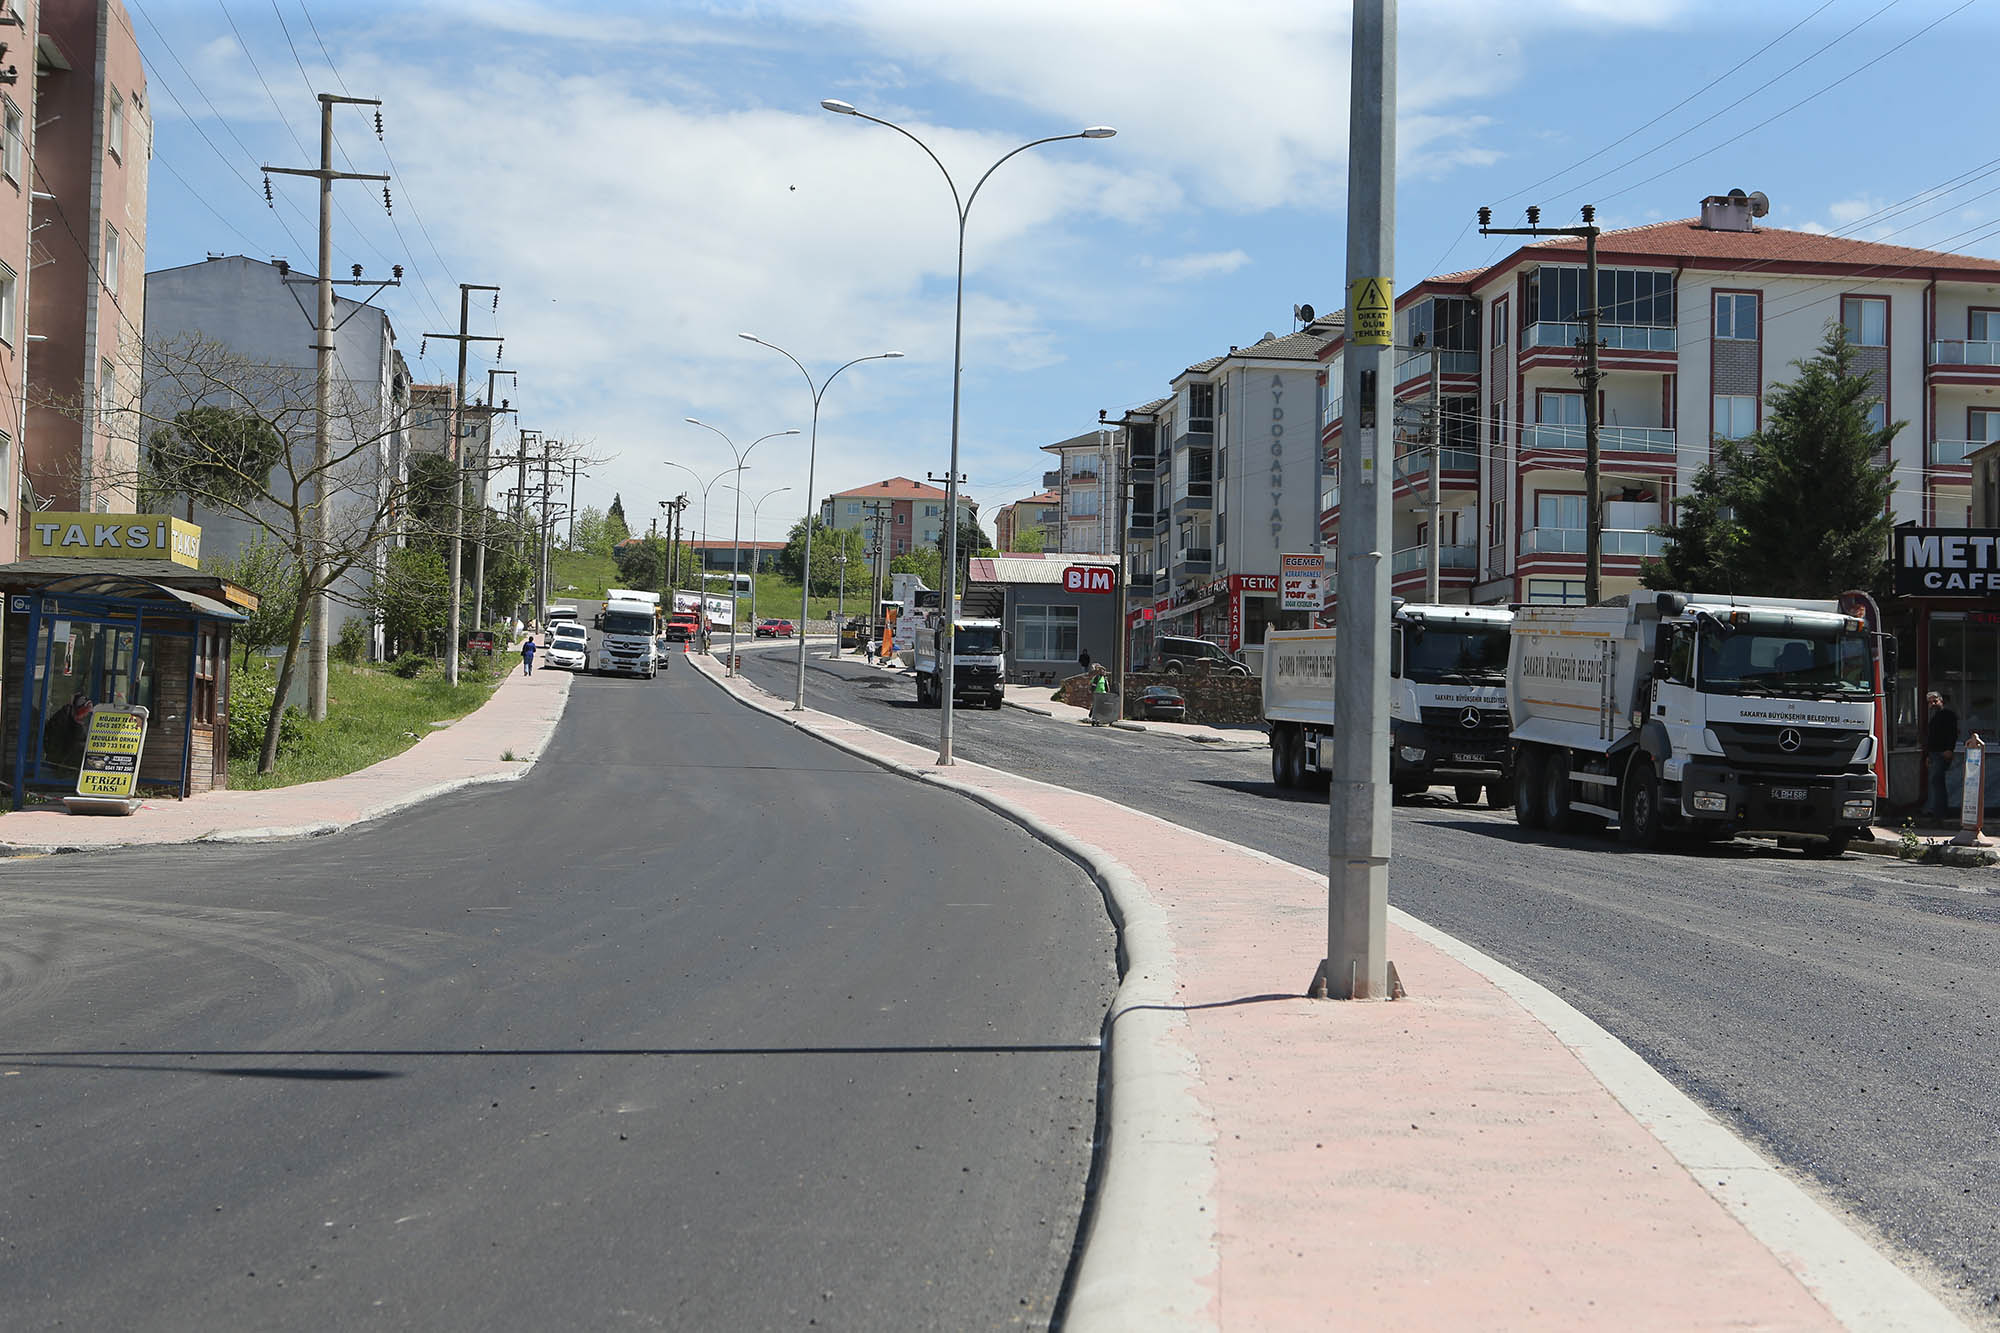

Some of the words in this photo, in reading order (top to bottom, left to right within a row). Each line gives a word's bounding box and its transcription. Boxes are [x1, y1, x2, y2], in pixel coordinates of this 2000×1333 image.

[36, 522, 166, 549] TAKSİ
[172, 529, 200, 560] TAKSİ
[1904, 536, 2000, 569] MET
[1286, 558, 1322, 566] EGEMEN
[1068, 568, 1110, 590] BİM
[1240, 576, 1276, 588] TETİK
[1285, 580, 1302, 590] ÇAY
[1924, 572, 2000, 590] CAFE
[1285, 591, 1306, 599] TOST
[1524, 656, 1544, 676] SAKARYA
[1740, 710, 1767, 719] SAKARYA
[1768, 712, 1806, 722] BÜYÜKŞEHİR
[1807, 714, 1840, 722] BELEDİYESİ
[85, 775, 127, 786] FERİZLİ
